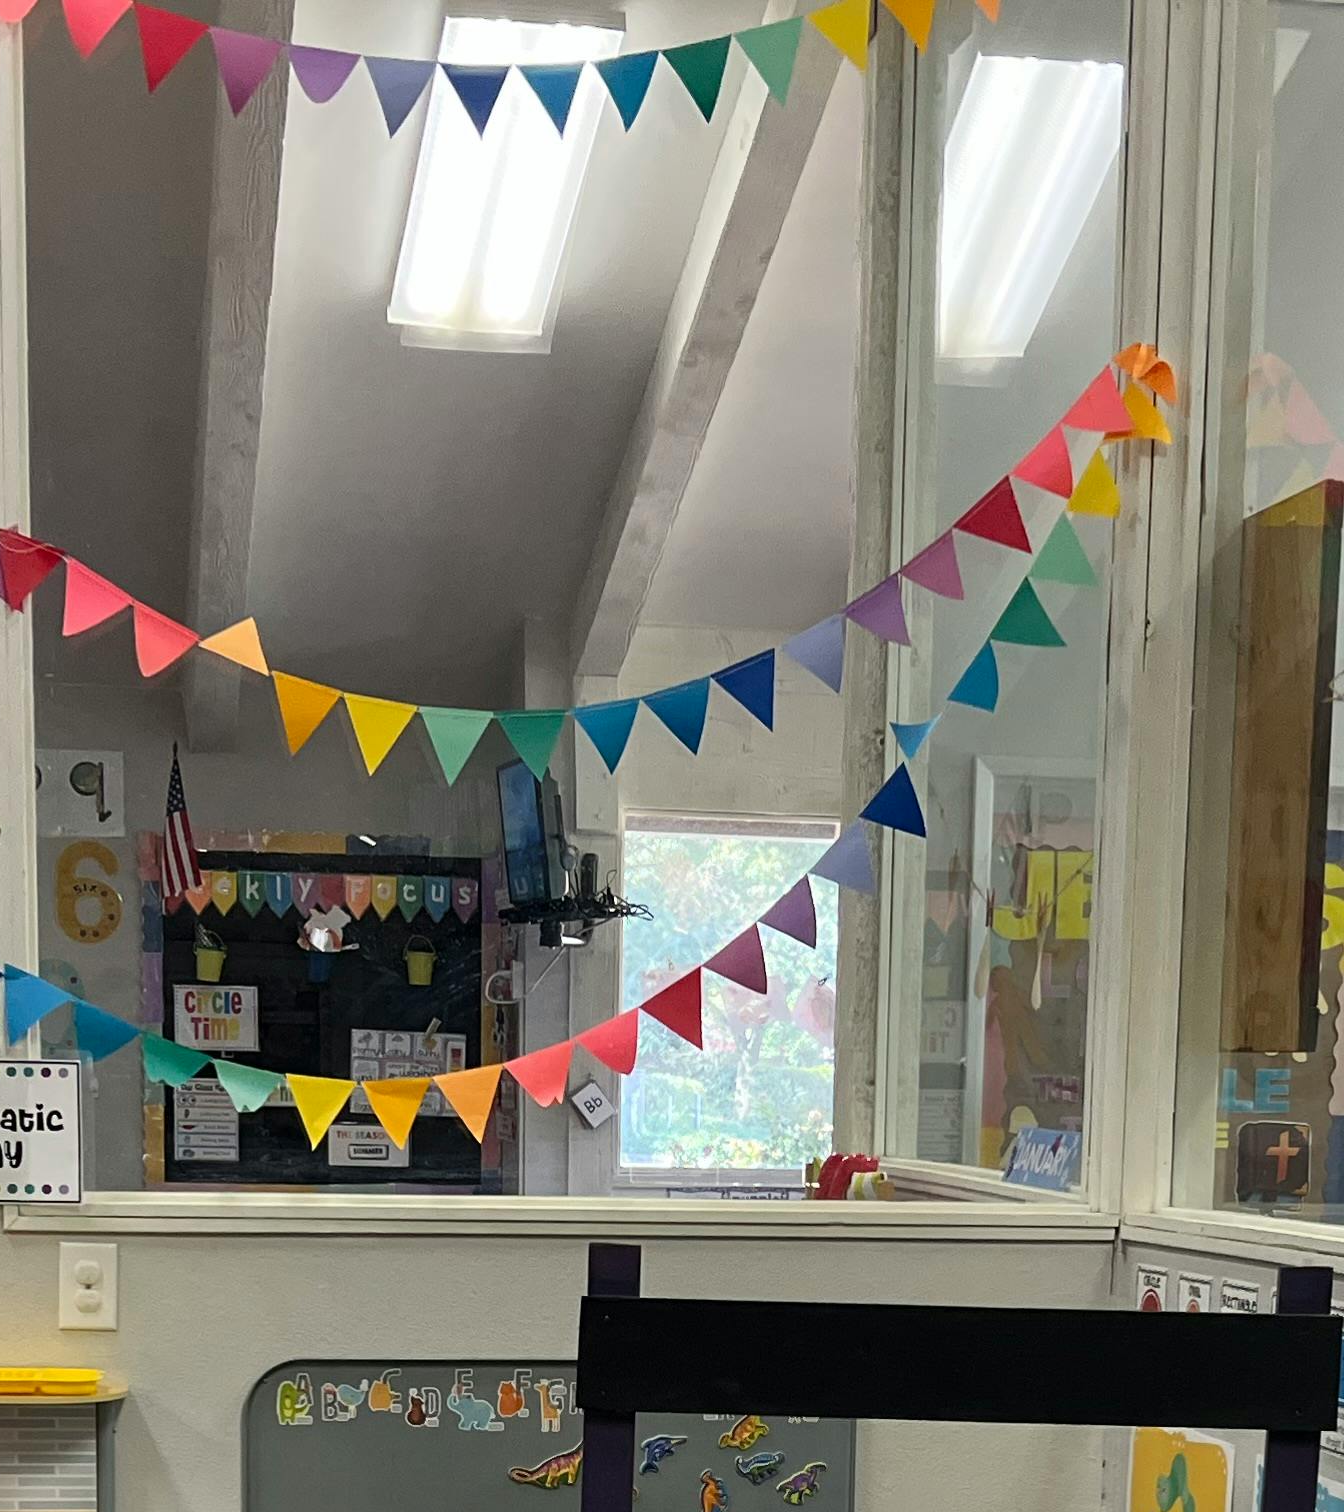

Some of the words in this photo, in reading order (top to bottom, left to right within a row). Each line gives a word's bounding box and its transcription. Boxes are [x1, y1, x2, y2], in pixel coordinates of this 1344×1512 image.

[69, 761, 112, 822] q
[57, 839, 123, 945] 6
[184, 991, 243, 1014] Circle
[191, 1017, 241, 1040] Time
[584, 1096, 603, 1114] Bb
[355, 1131, 385, 1139] SEASO
